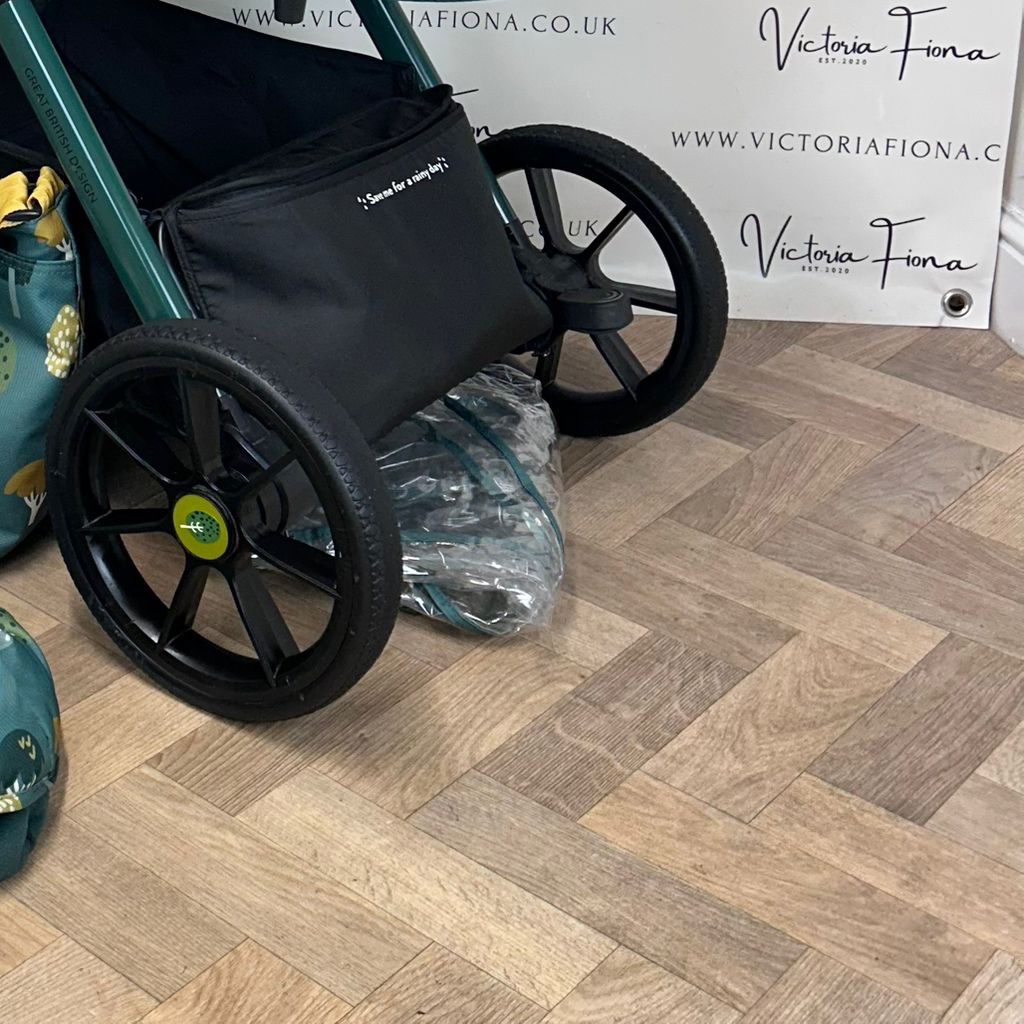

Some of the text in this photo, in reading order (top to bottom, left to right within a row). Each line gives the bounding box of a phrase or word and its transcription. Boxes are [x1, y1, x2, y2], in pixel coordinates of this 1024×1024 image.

[759, 6, 1001, 81] Victoria Fiona
[818, 57, 868, 65] EST.2020
[24, 67, 98, 204] GREAT BRITISH DESIGN
[391, 181, 406, 192] for
[406, 178, 413, 186] a
[411, 170, 432, 182] rainy
[427, 163, 445, 173] day
[740, 213, 978, 290] Victoria Fiona
[802, 266, 851, 274] EST.2020
